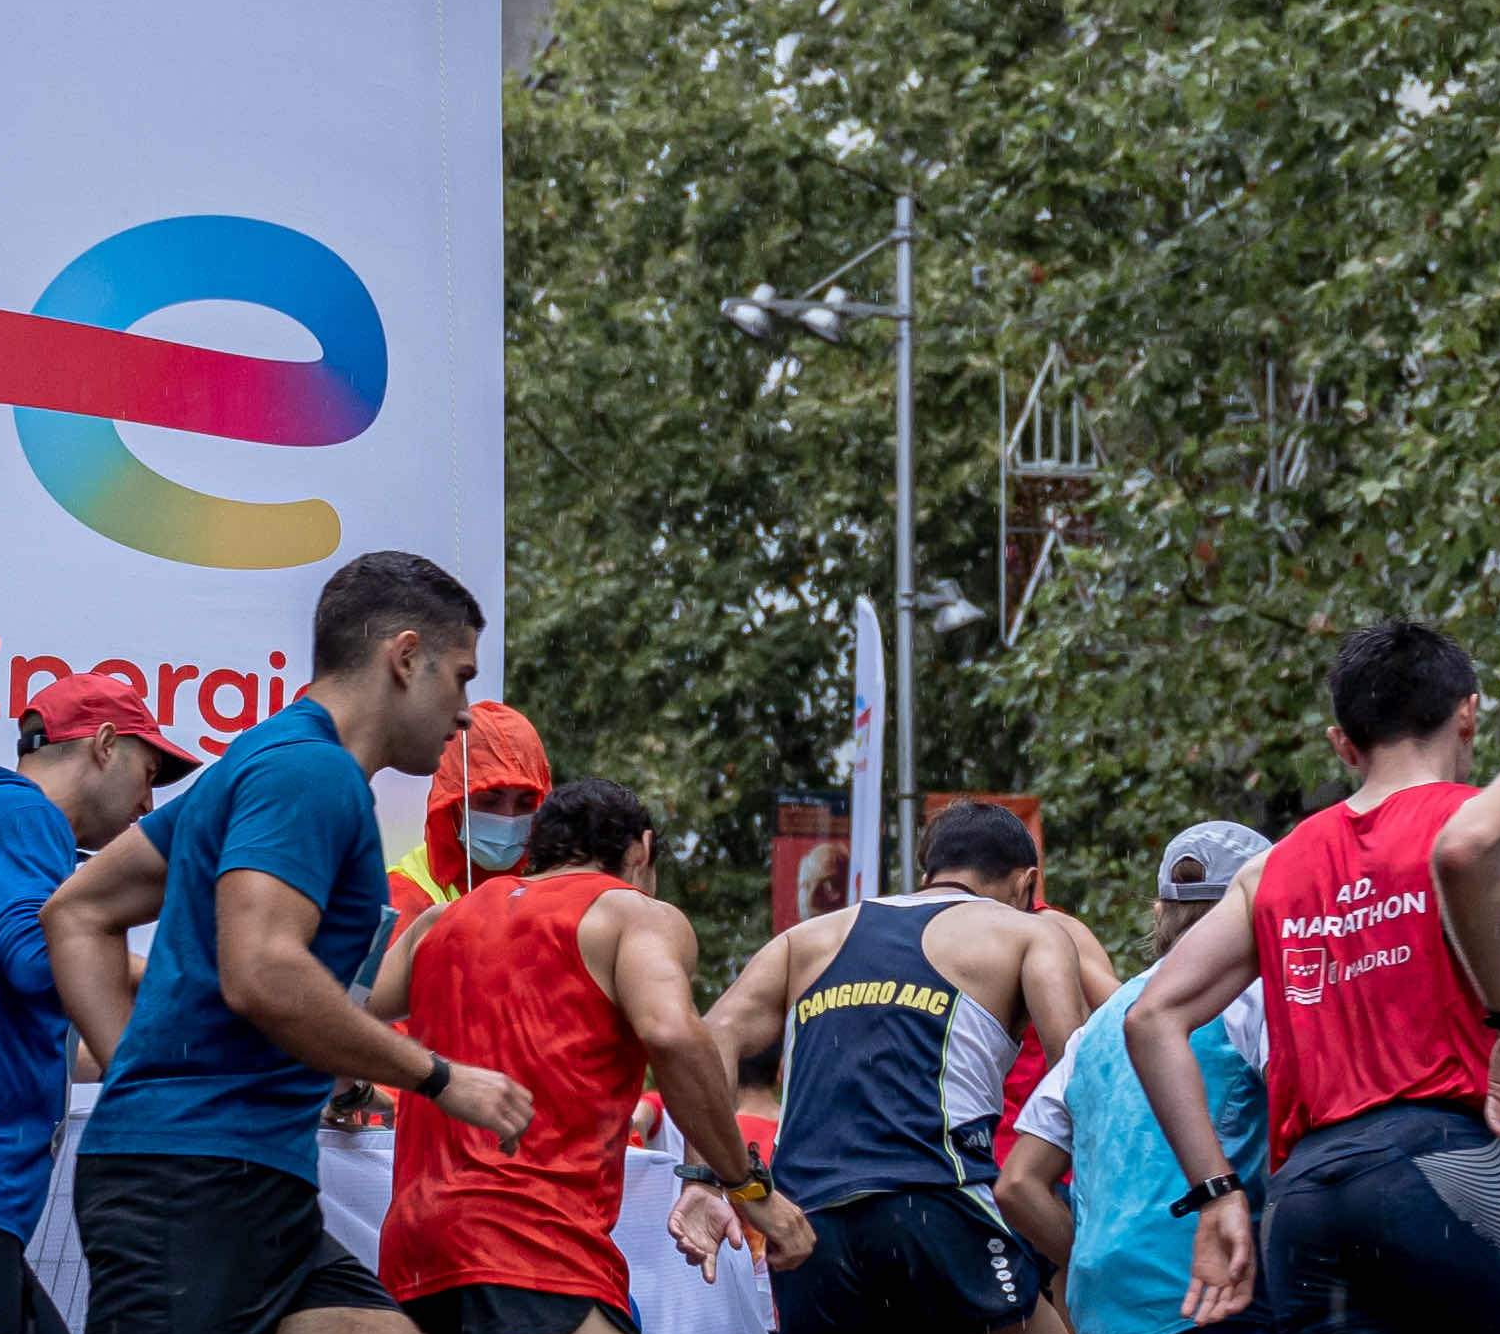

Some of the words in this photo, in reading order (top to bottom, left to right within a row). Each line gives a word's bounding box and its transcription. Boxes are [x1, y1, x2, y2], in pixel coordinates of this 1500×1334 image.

[1281, 891, 1426, 939] MARATHON
[1344, 945, 1411, 981] MADRID
[799, 980, 897, 1025] CANGURO
[895, 983, 950, 1015] AAC
